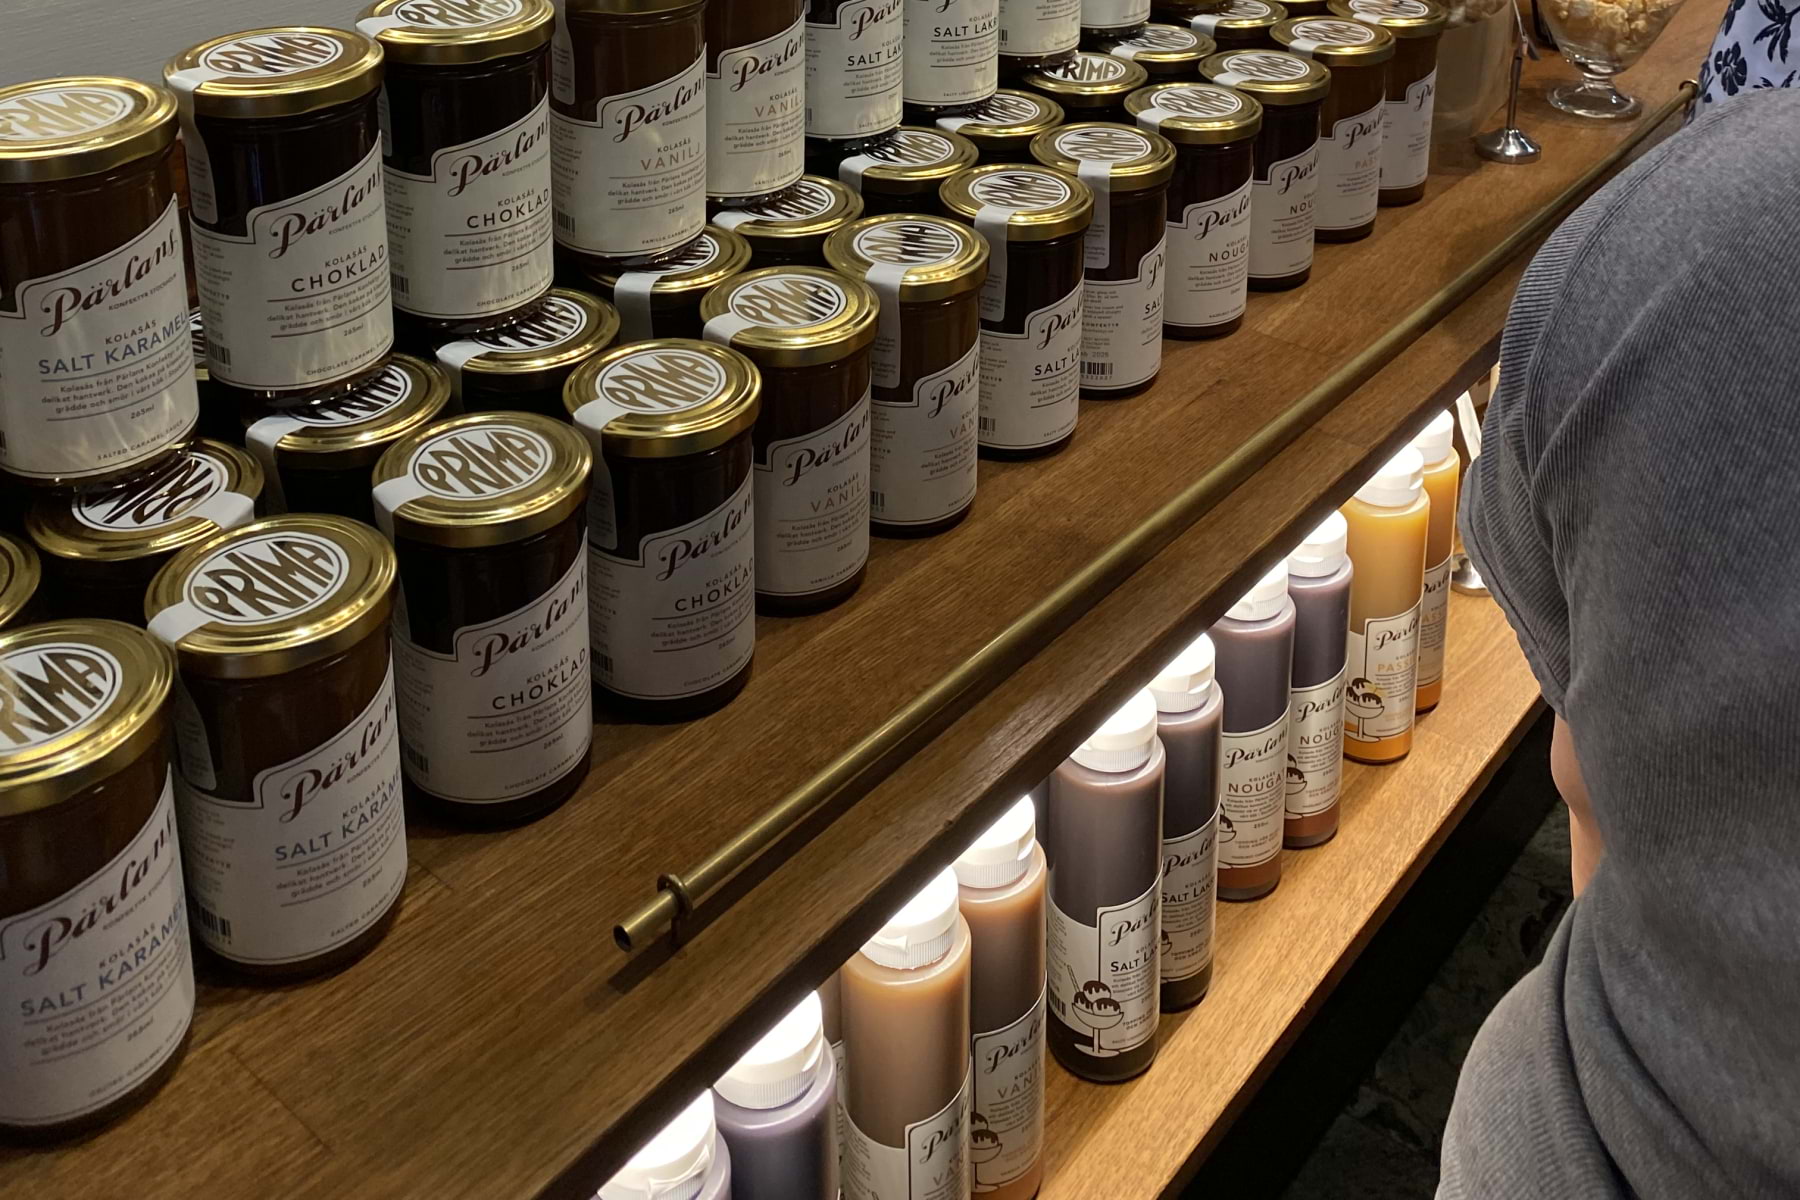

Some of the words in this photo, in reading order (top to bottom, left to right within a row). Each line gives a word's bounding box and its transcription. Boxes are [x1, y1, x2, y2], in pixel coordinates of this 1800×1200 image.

[933, 25, 969, 38] SALT
[208, 35, 336, 75] PRIMA
[847, 51, 883, 67] SALT
[1048, 56, 1120, 81] RIMA
[754, 96, 803, 118] VANIL
[640, 141, 701, 172] VANILJ
[657, 138, 692, 154] KOLASÅS
[466, 187, 549, 229] CHOKLAD
[497, 188, 536, 208] KOLASÅS
[290, 243, 385, 293] CHOKLAD
[324, 244, 368, 269] KOLASÅS
[40, 227, 181, 338] Pärlans
[108, 290, 150, 312] KONFEKTYR
[739, 279, 838, 327] PRIMA
[105, 319, 157, 346] KOLASÅS
[38, 352, 96, 376] SALT
[1034, 357, 1067, 376] SALT
[604, 354, 717, 411] PRIMA
[418, 431, 544, 496] PRIMA
[654, 490, 751, 584] Pärlan
[194, 539, 335, 618] PRIMA
[492, 648, 586, 711] CHOKLAD
[526, 655, 570, 685] KOLASÅS
[0, 652, 109, 746] RIMA
[278, 690, 396, 824] Pärlan
[342, 779, 386, 820] KOLASÅS
[275, 831, 333, 862] SALT
[99, 922, 156, 969] KOLASÅS
[20, 982, 87, 1018] SALT
